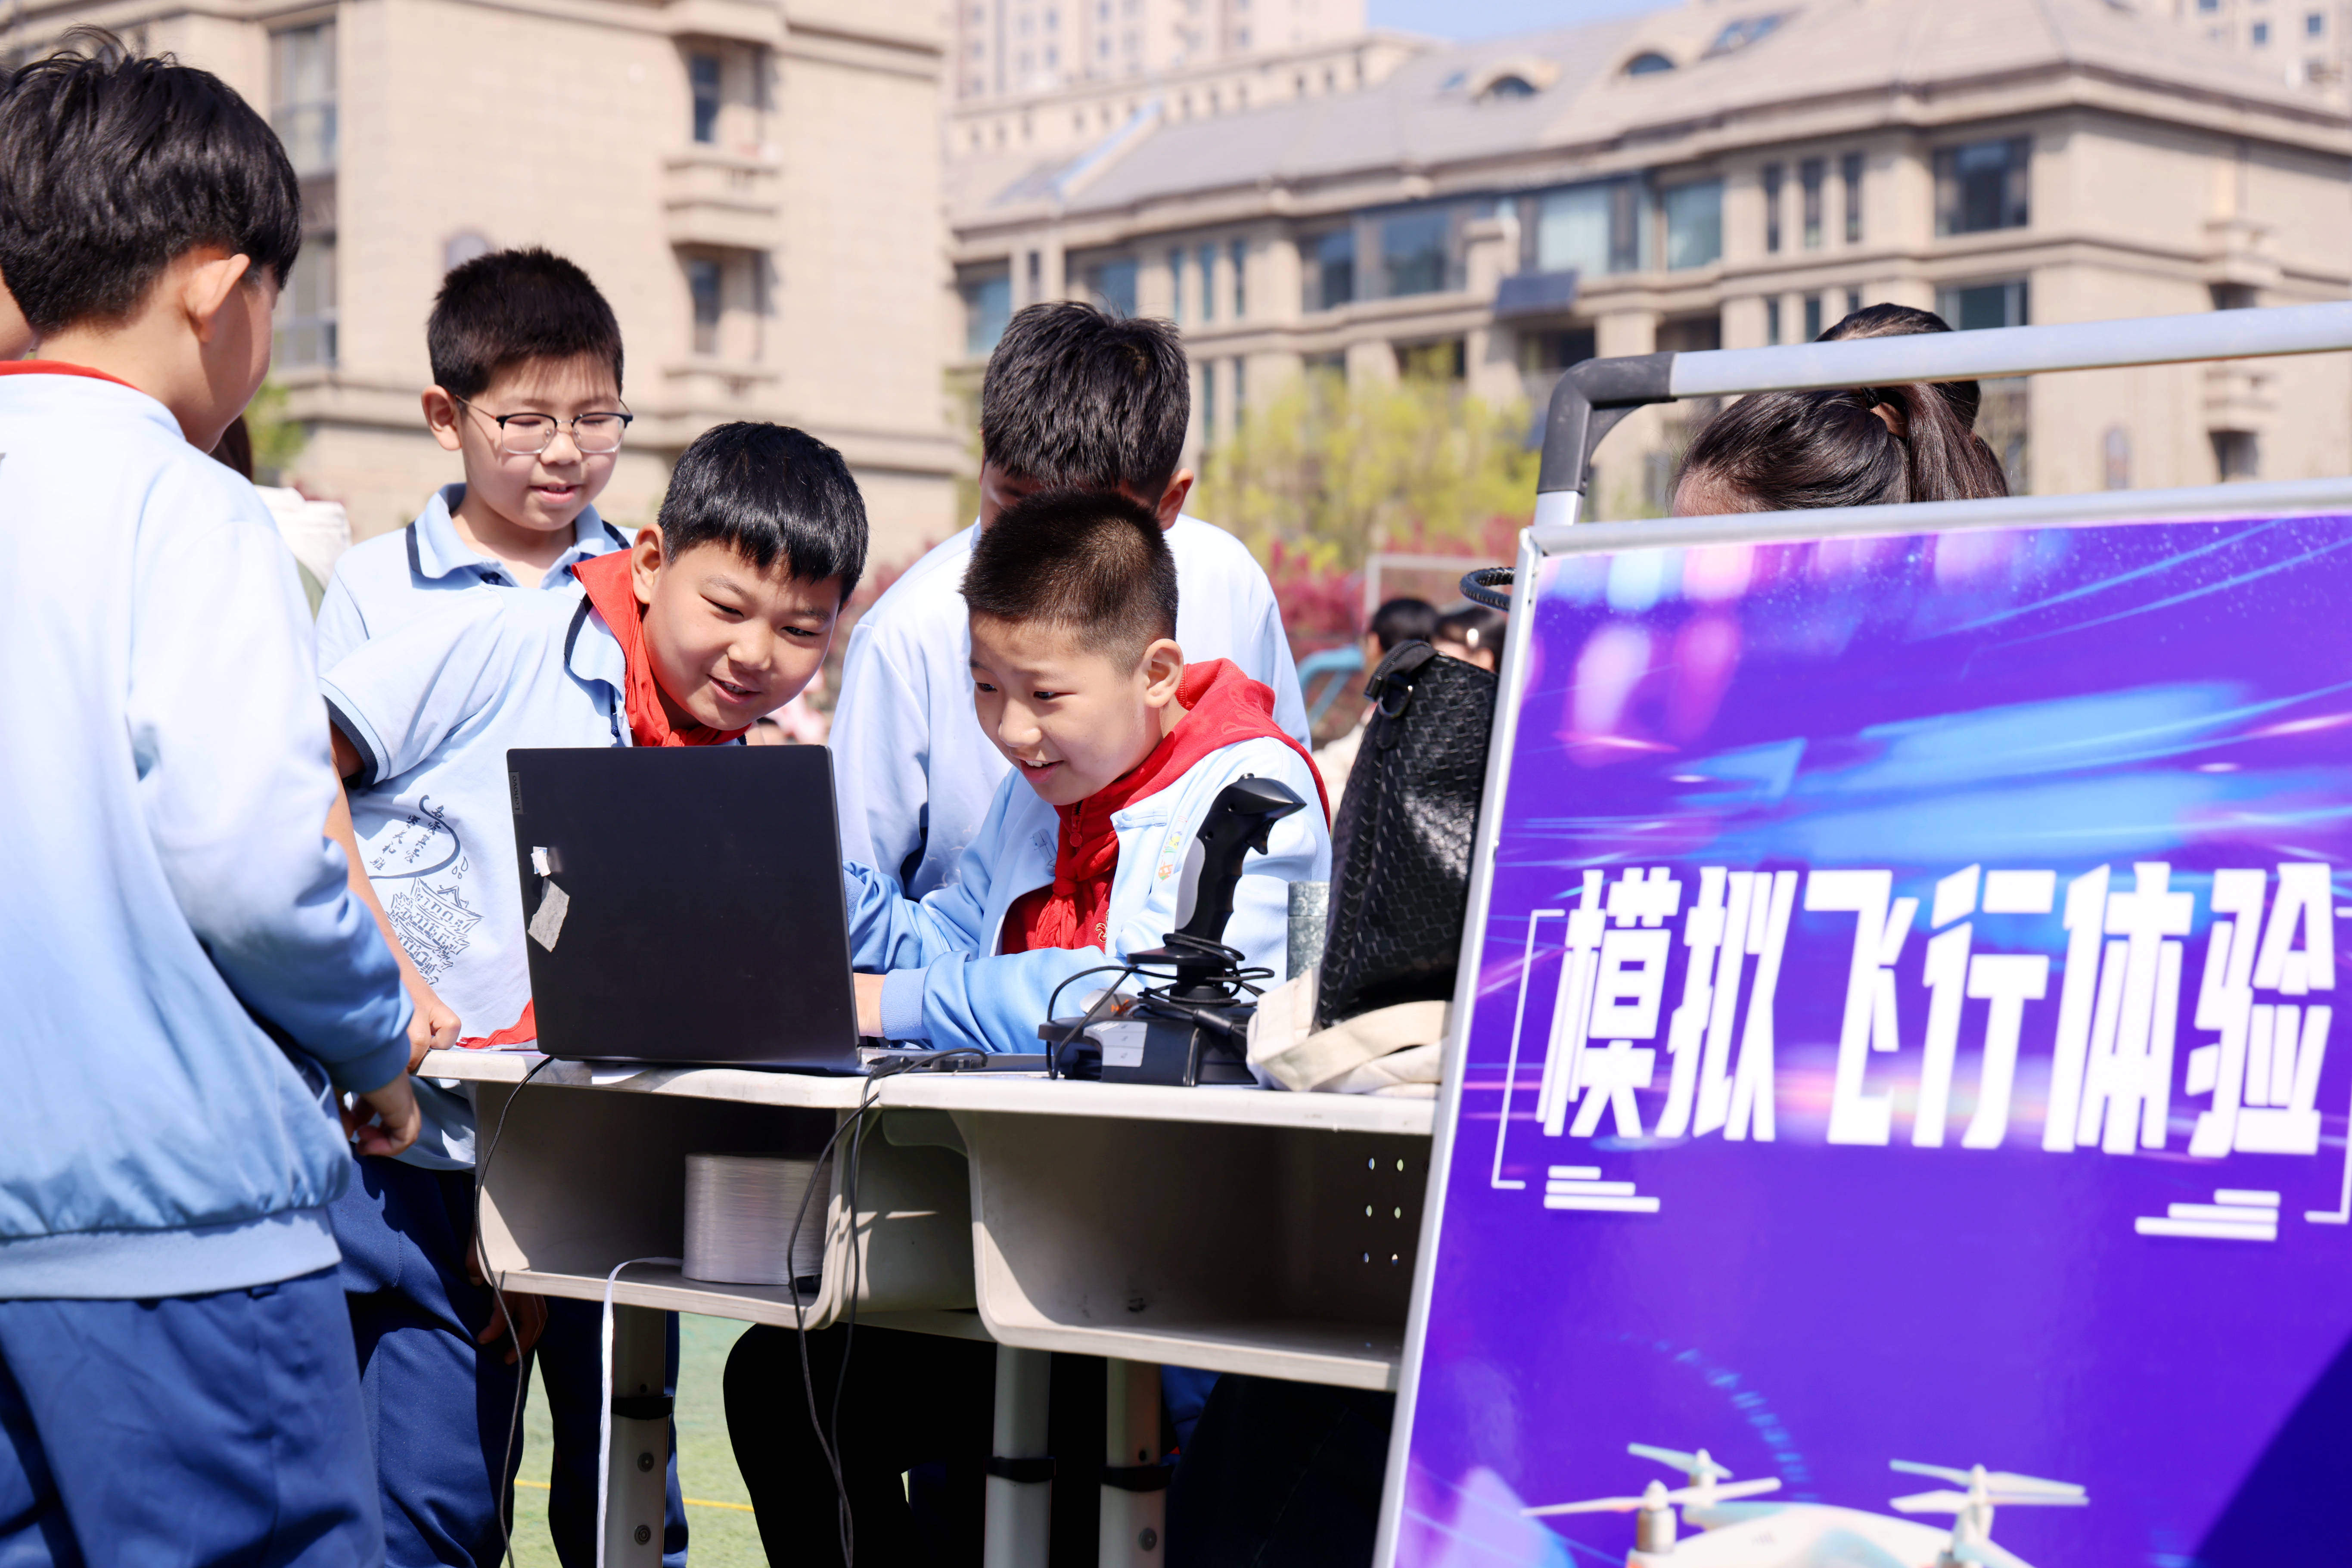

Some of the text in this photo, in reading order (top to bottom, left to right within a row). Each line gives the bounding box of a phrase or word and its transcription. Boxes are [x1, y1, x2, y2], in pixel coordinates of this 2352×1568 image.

[1536, 862, 2334, 1157] 模拟飞行体验
